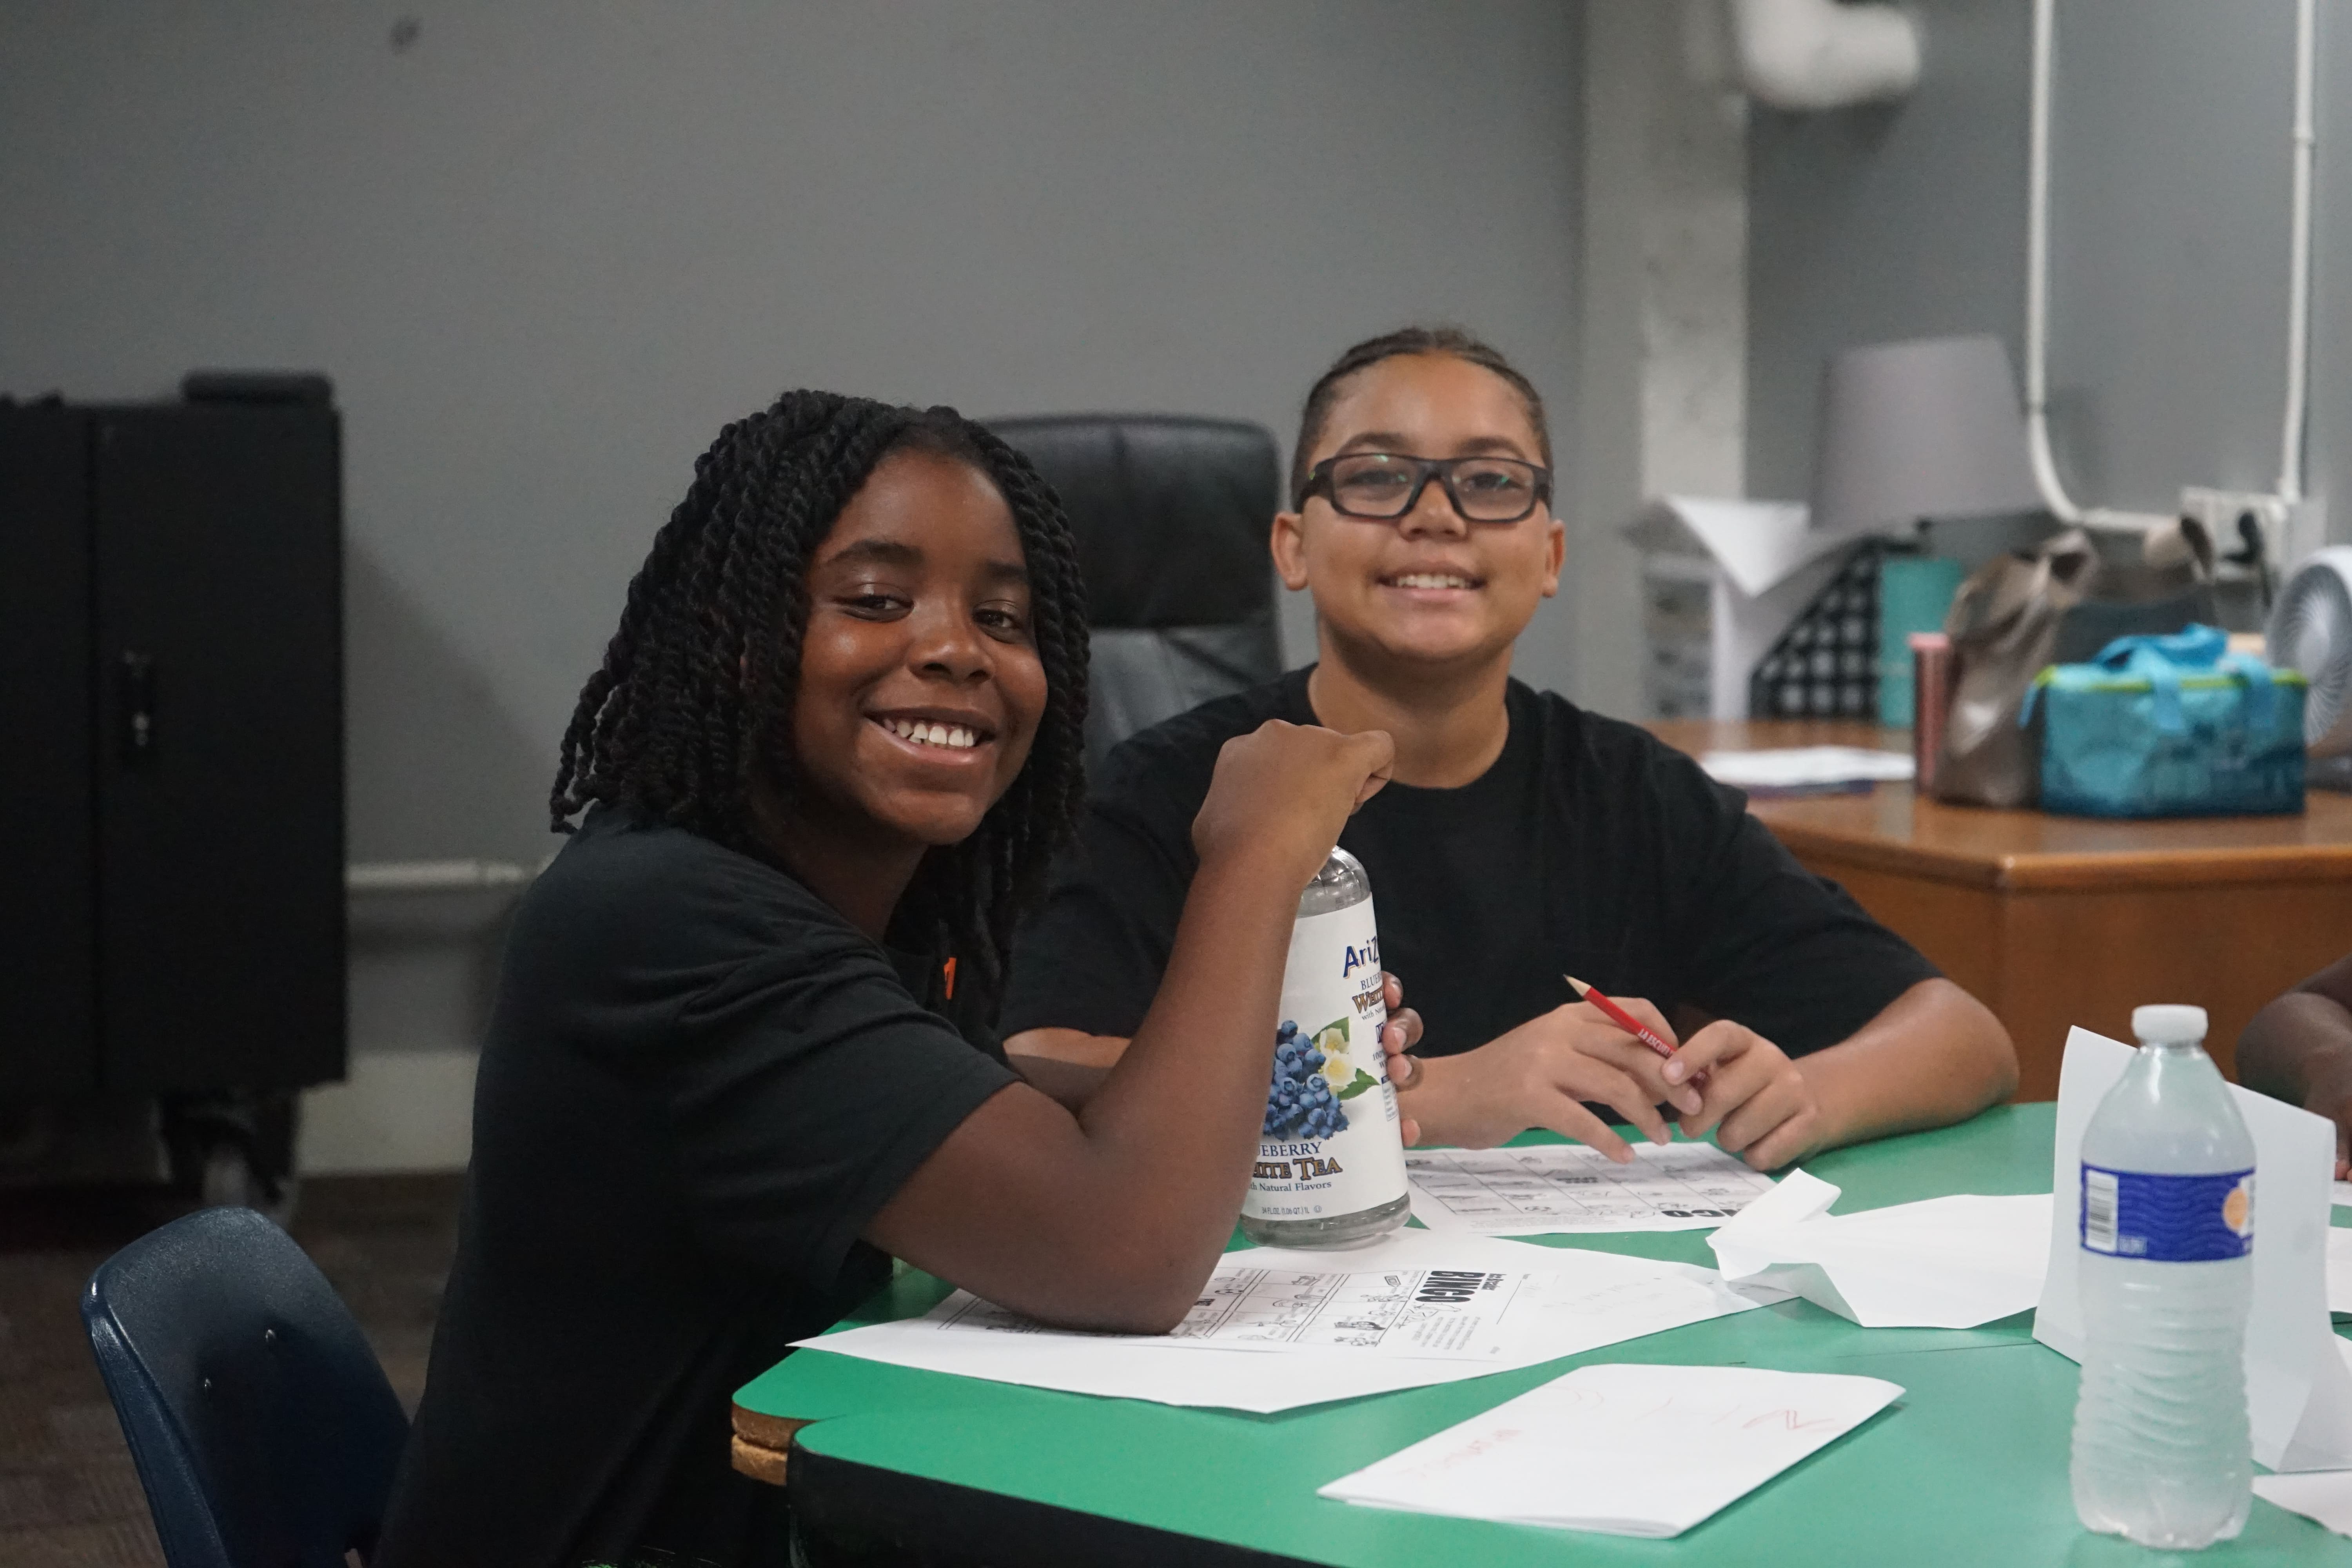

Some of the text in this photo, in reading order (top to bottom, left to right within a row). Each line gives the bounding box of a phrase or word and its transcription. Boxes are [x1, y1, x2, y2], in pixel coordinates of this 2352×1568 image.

[1360, 972, 1382, 990] BLUE
[1292, 1156, 1343, 1181] TEA
[1259, 1183, 1292, 1192] Natural
[1295, 1181, 1332, 1191] Flavors
[1415, 1270, 1486, 1303] BINGO
